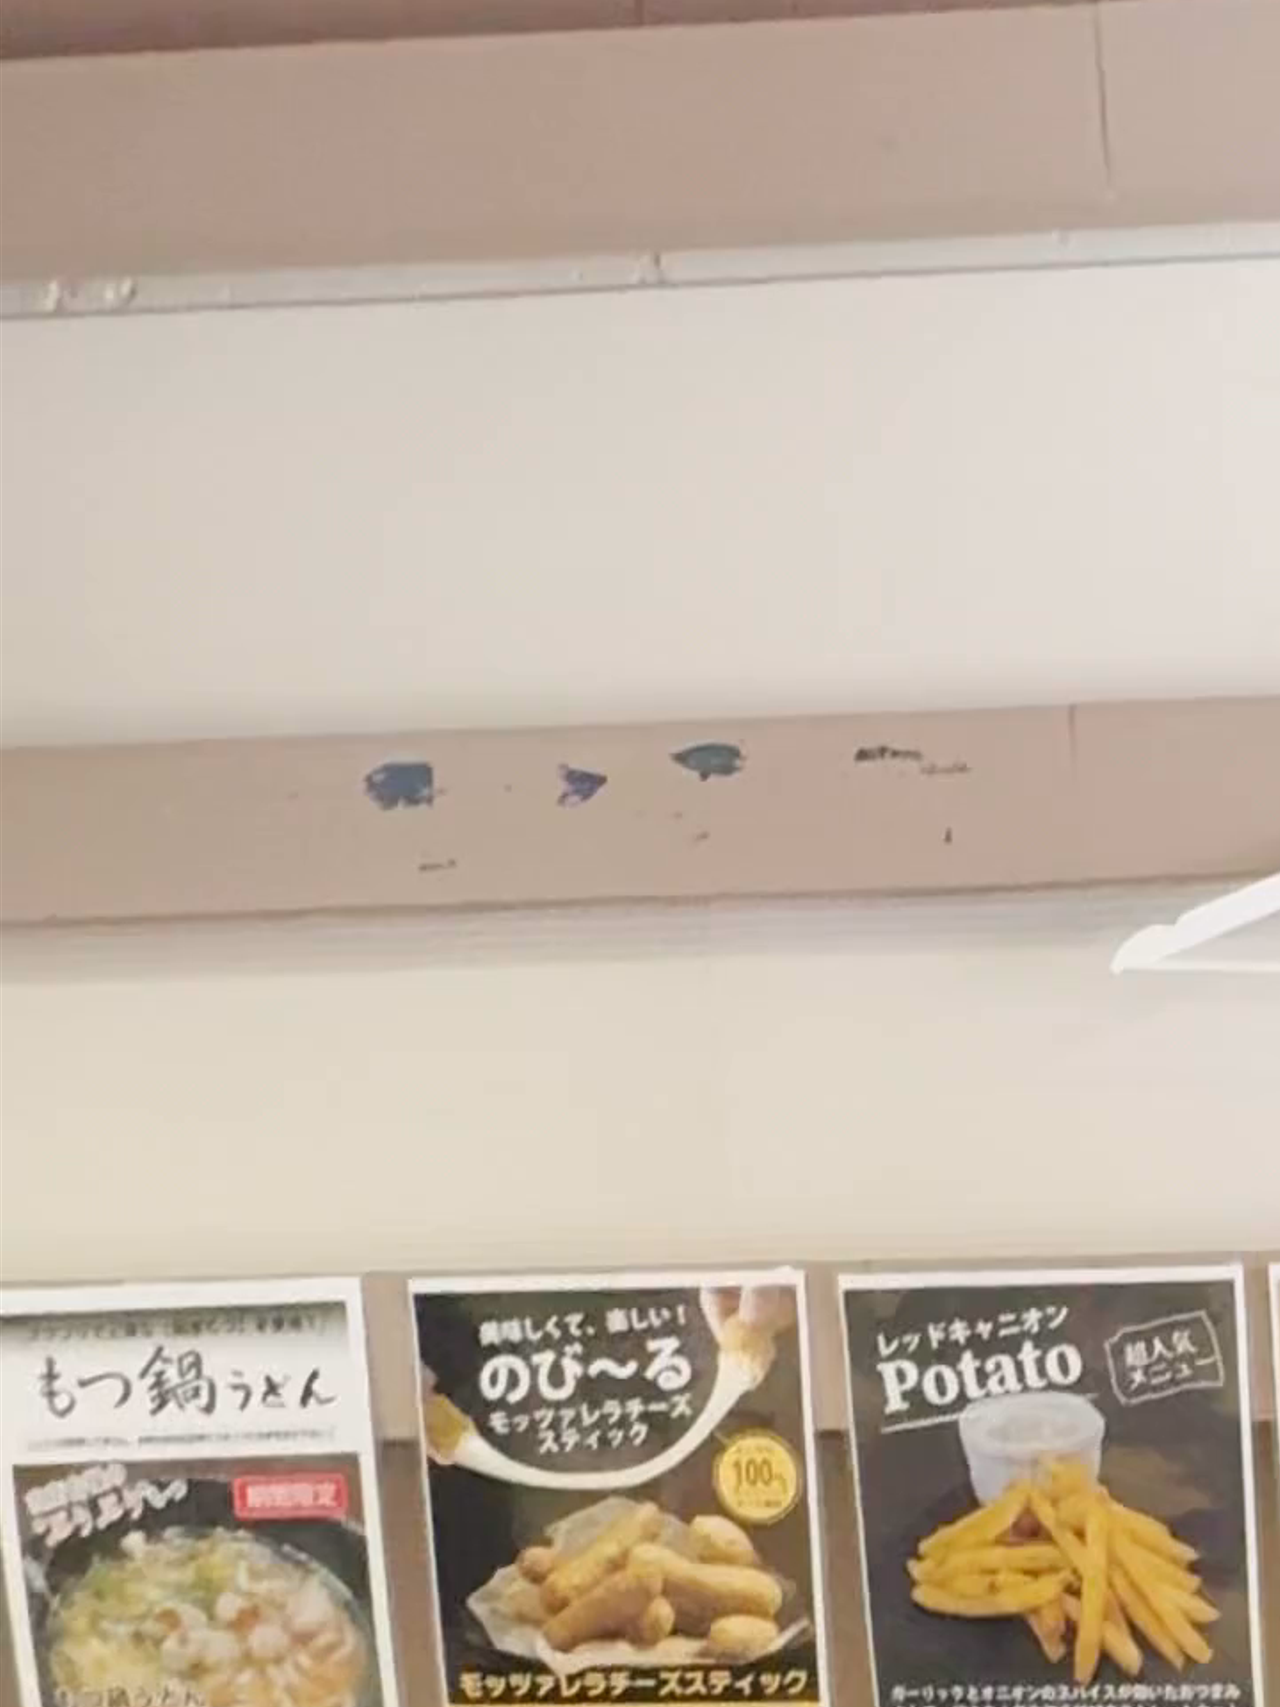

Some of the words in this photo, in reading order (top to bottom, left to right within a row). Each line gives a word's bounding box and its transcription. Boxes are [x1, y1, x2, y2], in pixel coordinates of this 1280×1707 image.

[876, 1305, 1070, 1357] レッドキャニオン
[1123, 1327, 1199, 1367] 超人気
[37, 1346, 338, 1419] もつ鍋うどん
[877, 1342, 1084, 1414] Potato
[487, 1392, 693, 1436] モッツァレラチーズ
[537, 1422, 648, 1455] スティック
[459, 1669, 808, 1698] モッツァレラチーズスティック
